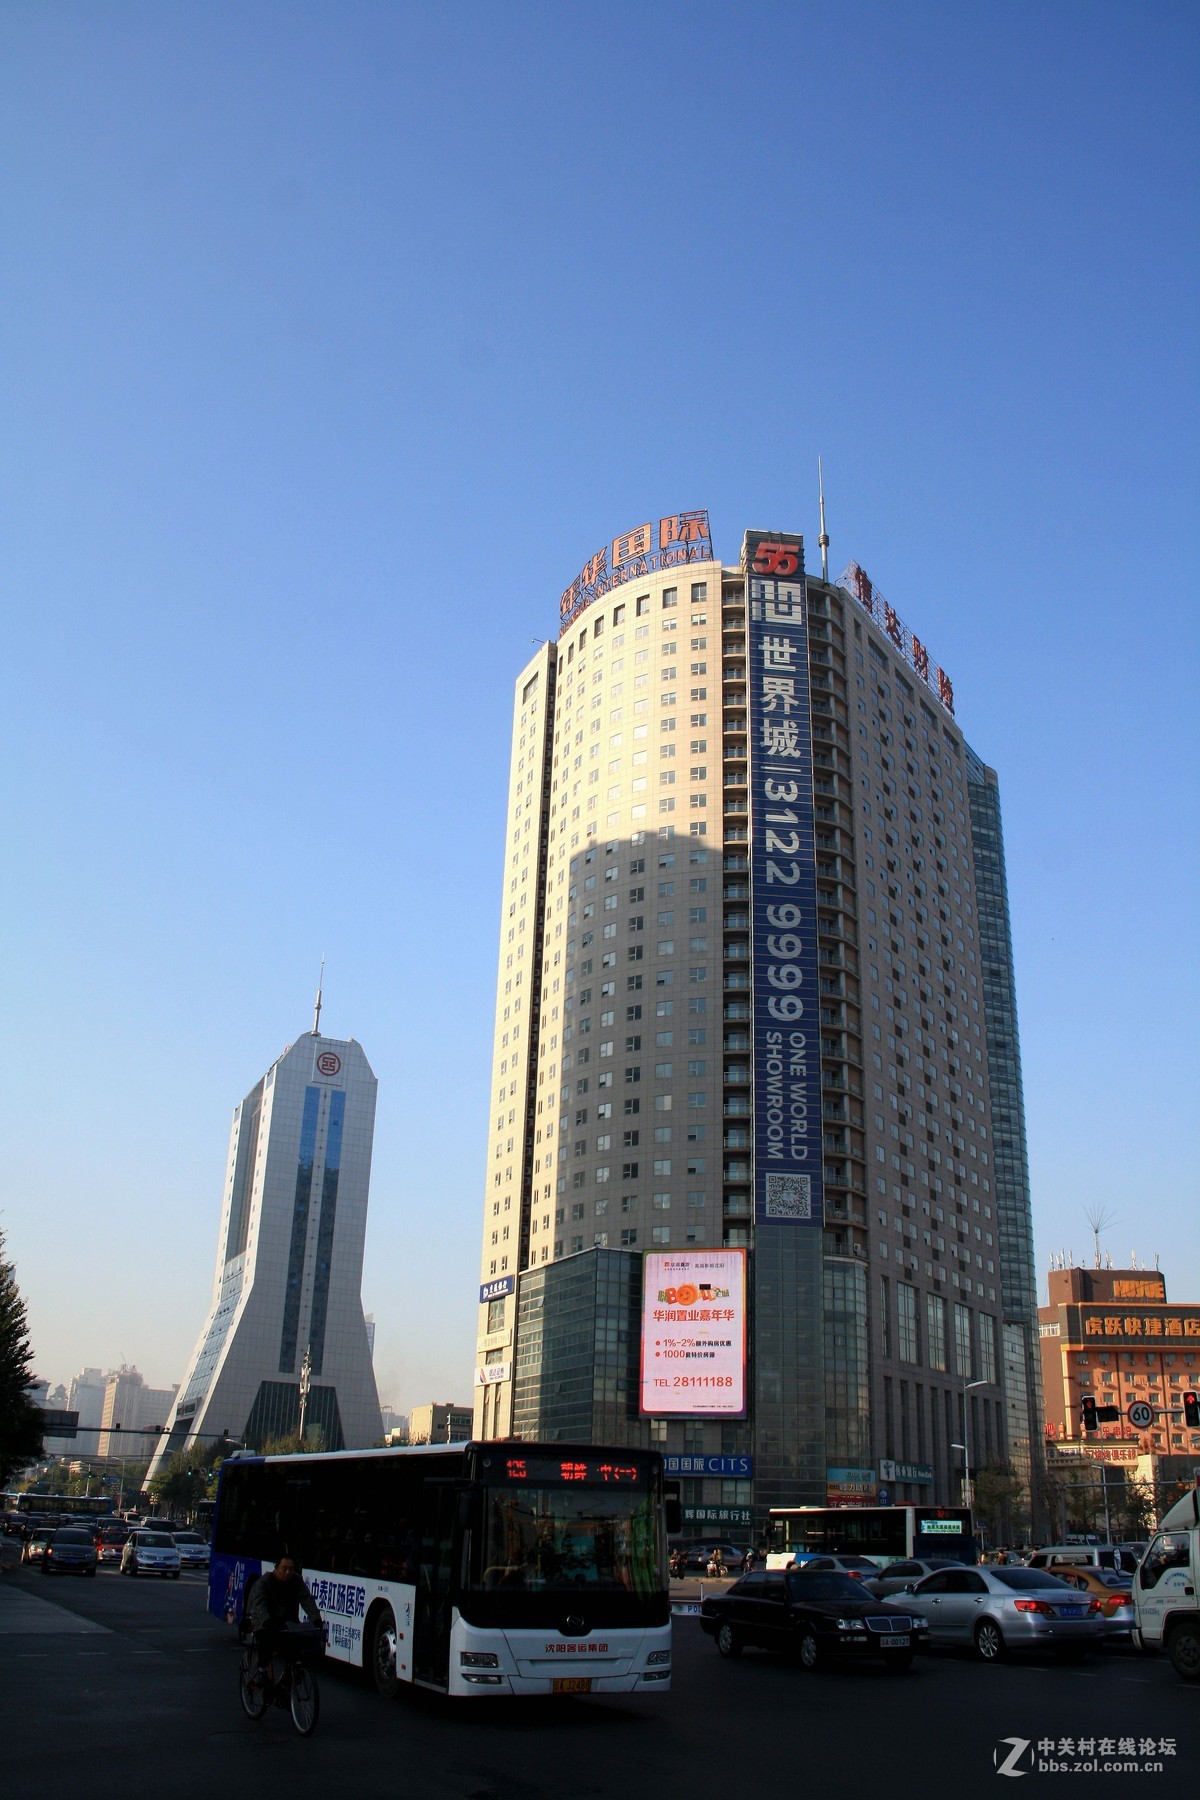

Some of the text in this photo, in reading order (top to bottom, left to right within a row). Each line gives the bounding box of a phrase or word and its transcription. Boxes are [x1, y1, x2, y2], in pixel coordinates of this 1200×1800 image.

[594, 545, 711, 600] INTERNATIONAL
[758, 636, 802, 758] 世界城
[766, 1031, 784, 1159] SHOWROOM
[789, 1032, 808, 1160] ONE WORLD
[1113, 1280, 1165, 1298] HUYUE
[653, 1309, 734, 1322] 华润置业嘉年华
[1085, 1316, 1200, 1337] 虎跃快捷酒店
[653, 1376, 733, 1388] TEL 28111188
[1132, 1407, 1151, 1422] 60
[708, 1459, 748, 1472] CITS
[311, 1578, 366, 1618] 中泰肛肠医院
[545, 1643, 608, 1653] 沈阳客运集团
